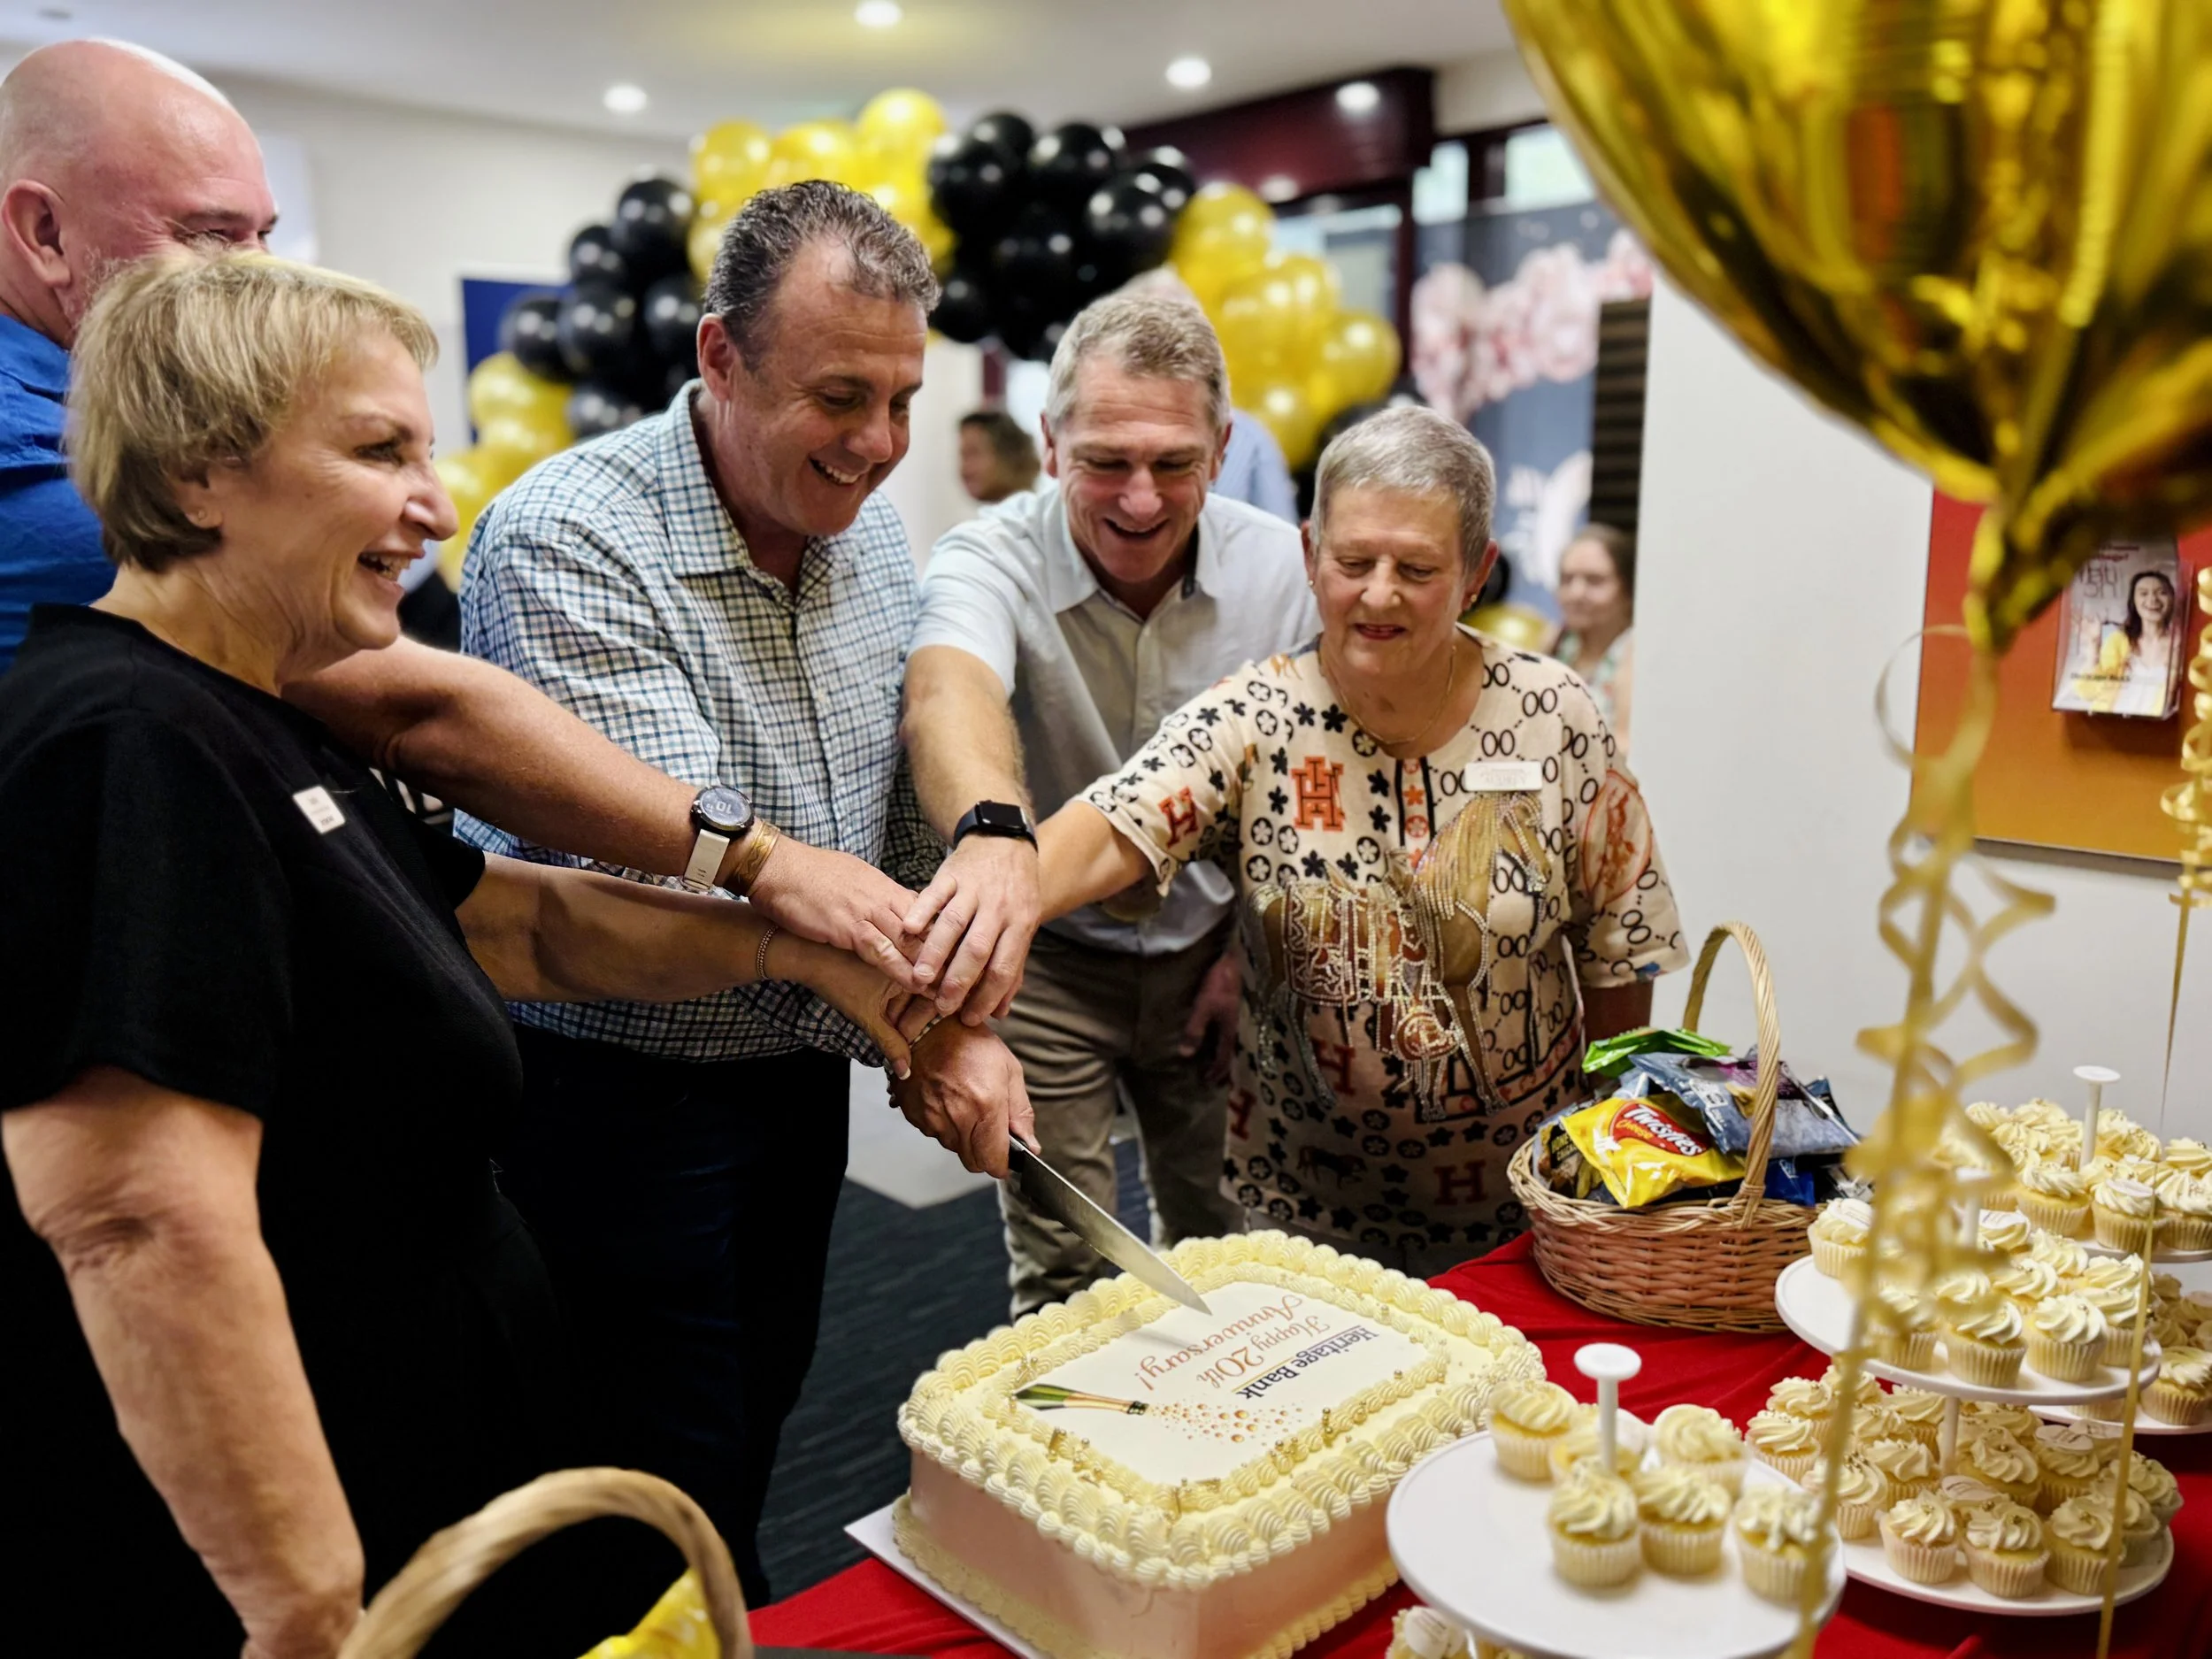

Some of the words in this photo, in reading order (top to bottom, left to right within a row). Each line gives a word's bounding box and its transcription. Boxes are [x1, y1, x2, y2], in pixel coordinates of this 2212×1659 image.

[1616, 1119, 1654, 1140] Cheese
[1624, 1103, 1702, 1156] Twisties
[1134, 1294, 1302, 1391] Anniversary!
[1250, 1315, 1330, 1351] Happy
[1291, 1327, 1379, 1370] Heritage
[1196, 1346, 1263, 1389] 20th
[1236, 1365, 1300, 1400] Bank
